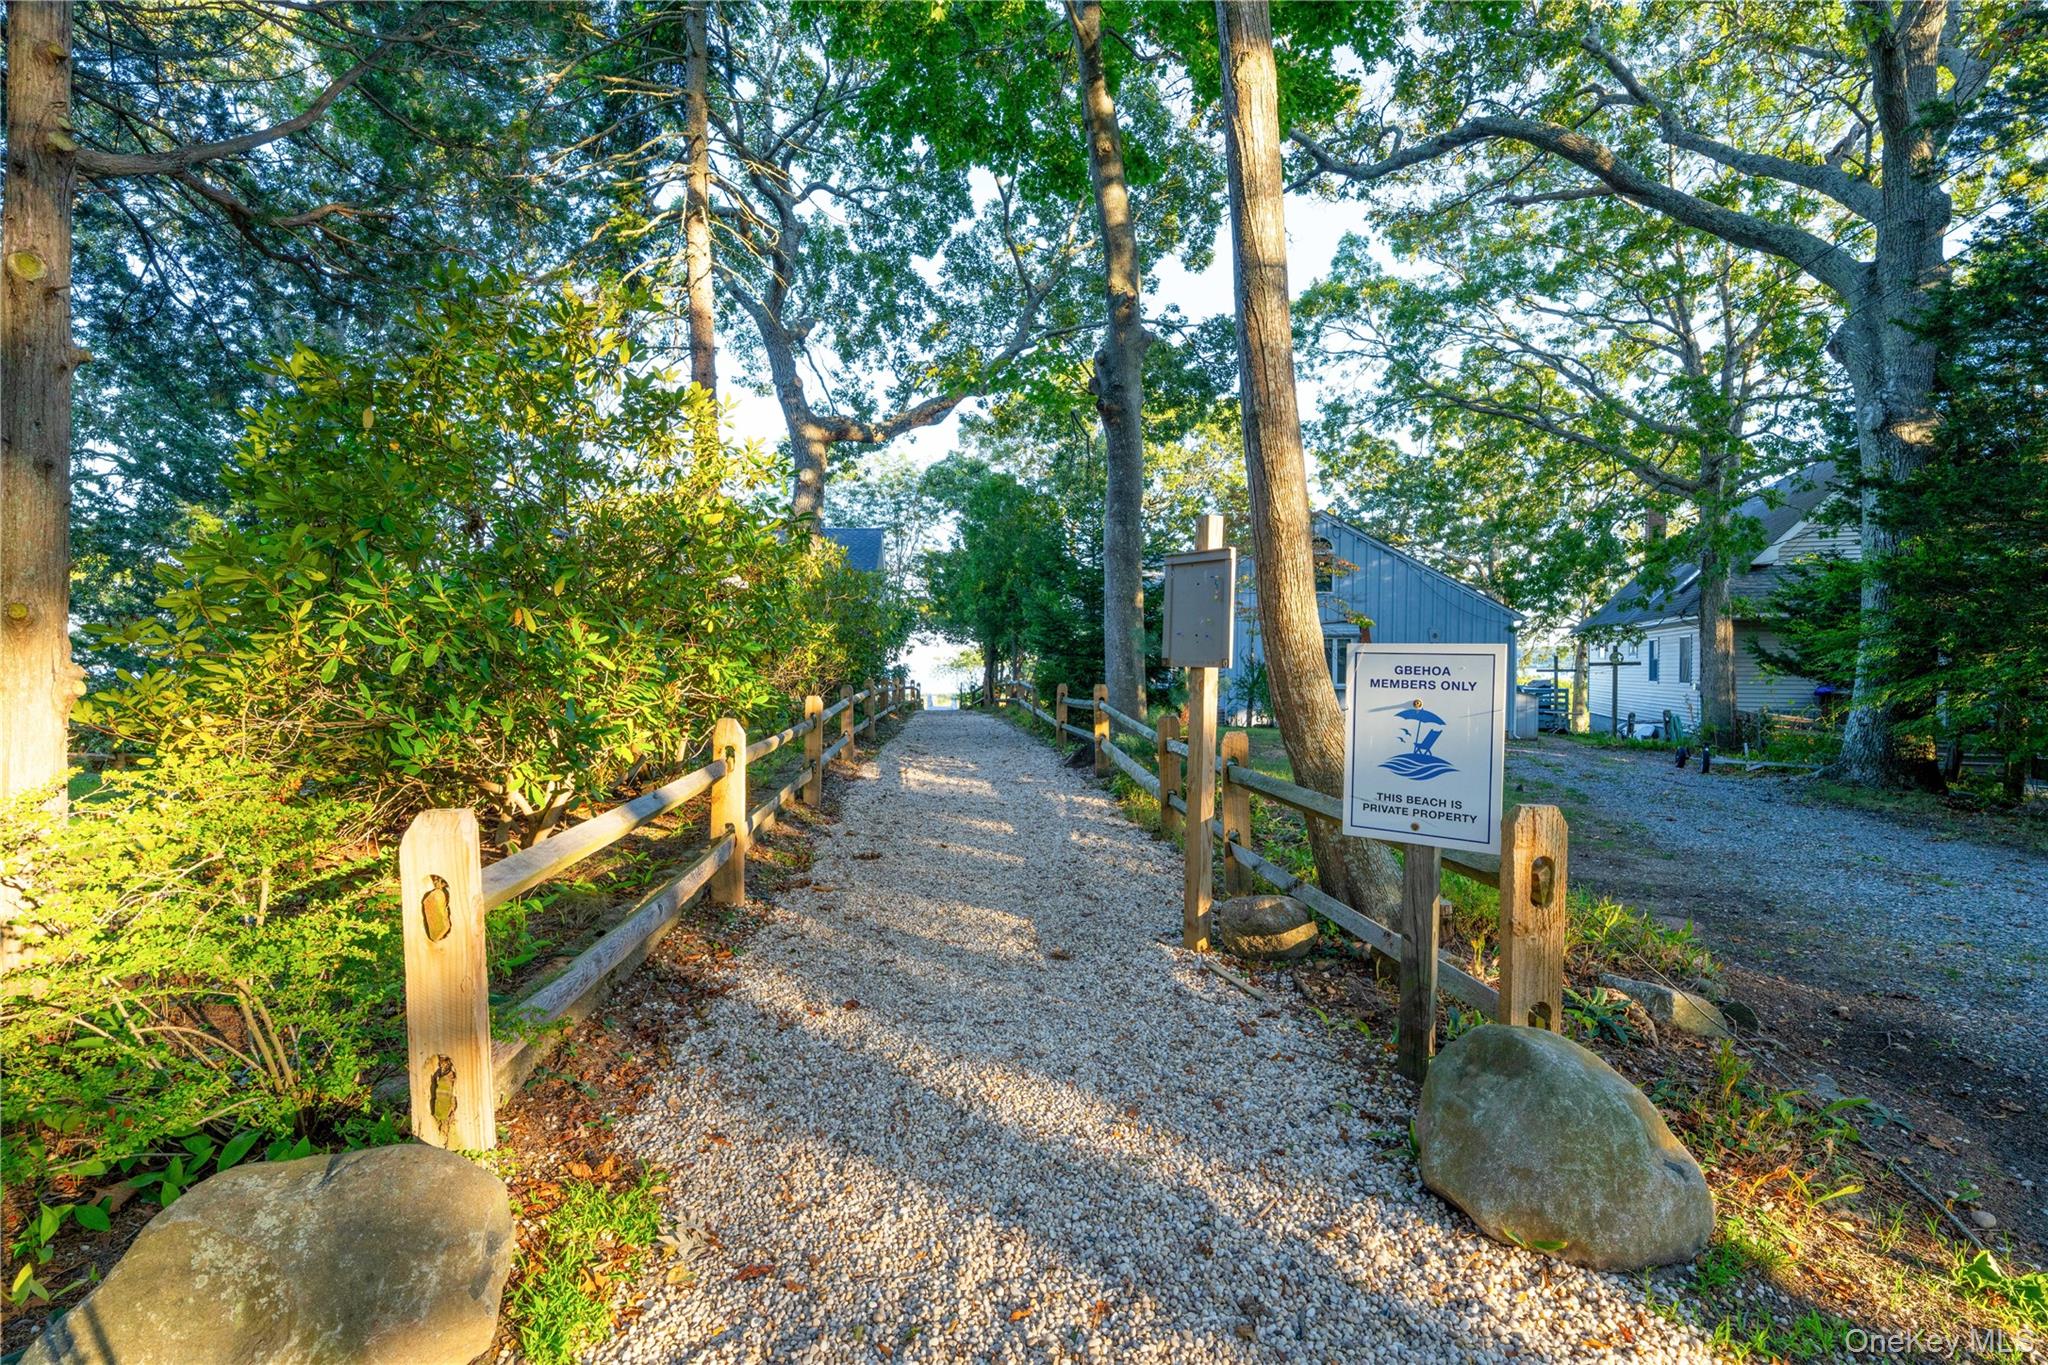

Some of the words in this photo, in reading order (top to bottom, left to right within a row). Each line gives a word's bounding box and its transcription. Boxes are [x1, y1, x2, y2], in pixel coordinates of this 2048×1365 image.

[1394, 665, 1451, 676] GBEHOA
[1370, 679, 1436, 690] MEMBERS
[1440, 680, 1478, 691] ONLY
[1376, 792, 1403, 804] THIS
[1406, 796, 1447, 808] BEACH
[1451, 800, 1463, 810] IS
[1362, 803, 1409, 816] PRIVATE
[1412, 809, 1478, 824] PROPERTY
